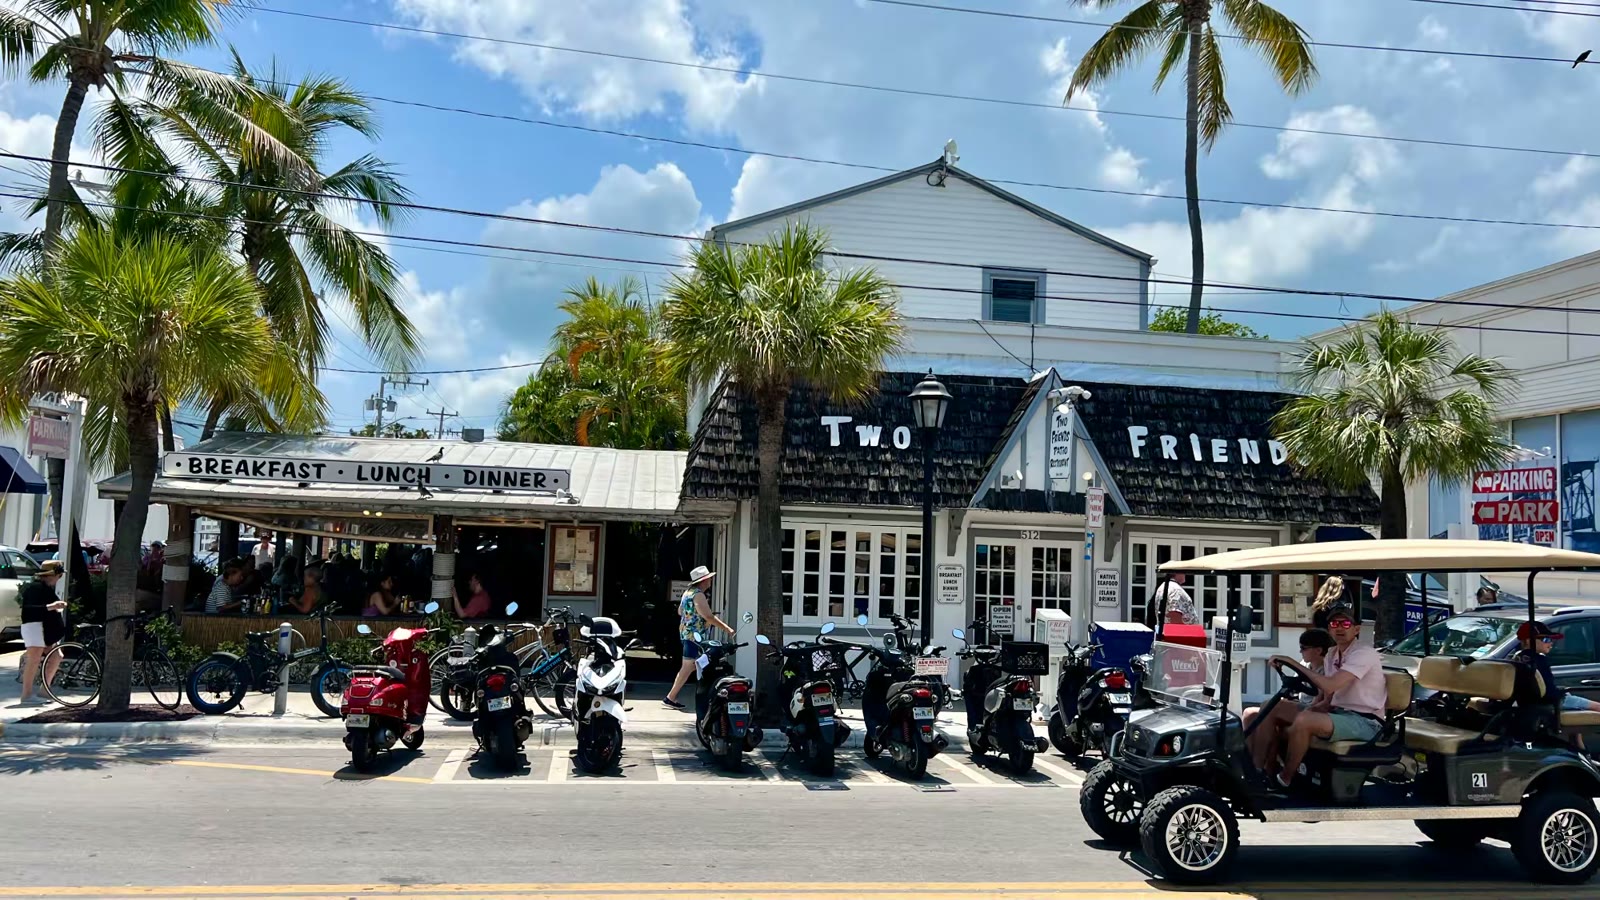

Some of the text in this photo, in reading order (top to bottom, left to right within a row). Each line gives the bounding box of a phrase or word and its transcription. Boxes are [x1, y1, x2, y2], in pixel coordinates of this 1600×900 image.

[32, 420, 69, 441] PARKING
[820, 415, 912, 450] TWO
[1127, 425, 1290, 466] FRIEND
[188, 456, 547, 489] BREAKFAST LUNCH DINNER
[1491, 468, 1554, 491] PARKING
[1497, 502, 1554, 522] PARK
[1021, 530, 1040, 540] 512
[1535, 530, 1555, 542] OPEN
[1172, 659, 1199, 670] WEEKLY
[1473, 773, 1486, 787] 21
